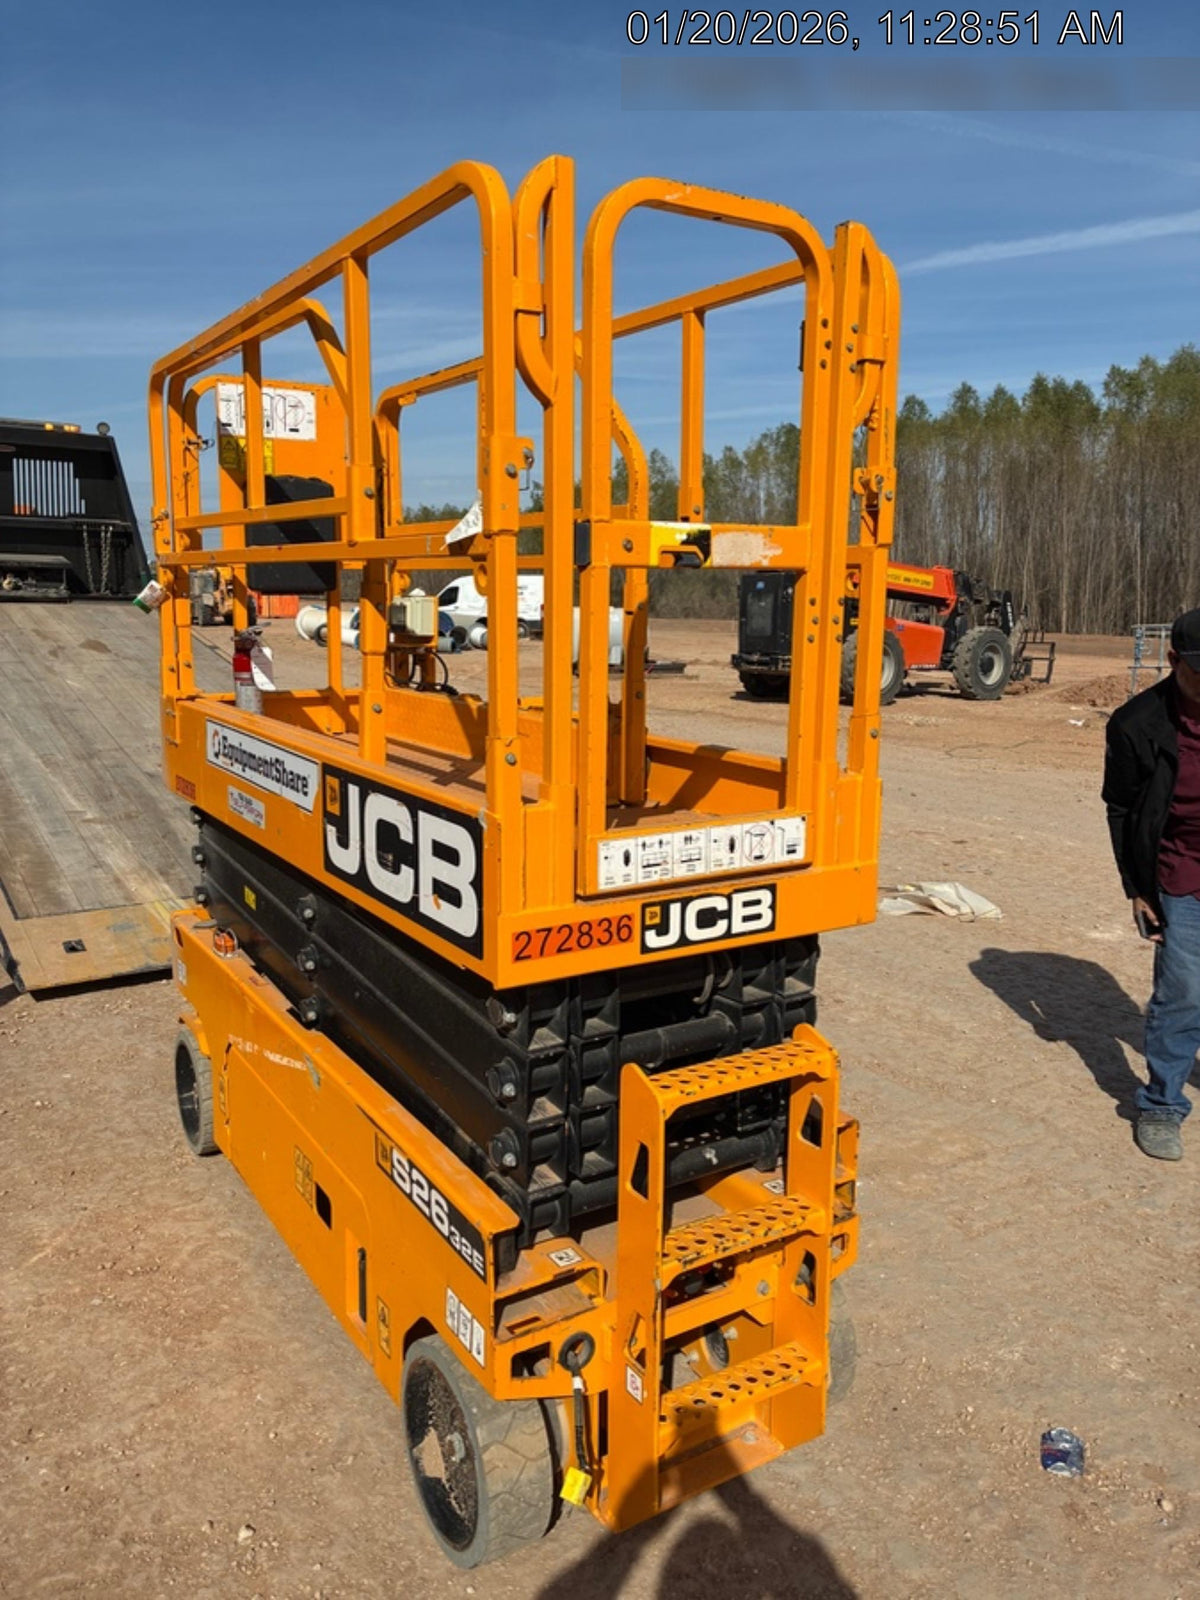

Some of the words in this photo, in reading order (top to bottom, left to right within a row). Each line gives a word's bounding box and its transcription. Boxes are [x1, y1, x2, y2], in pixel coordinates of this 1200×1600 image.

[221, 735, 309, 798] EquipmentShare
[325, 783, 479, 938] JCB
[514, 914, 633, 962] 272836
[644, 888, 775, 950] JCB
